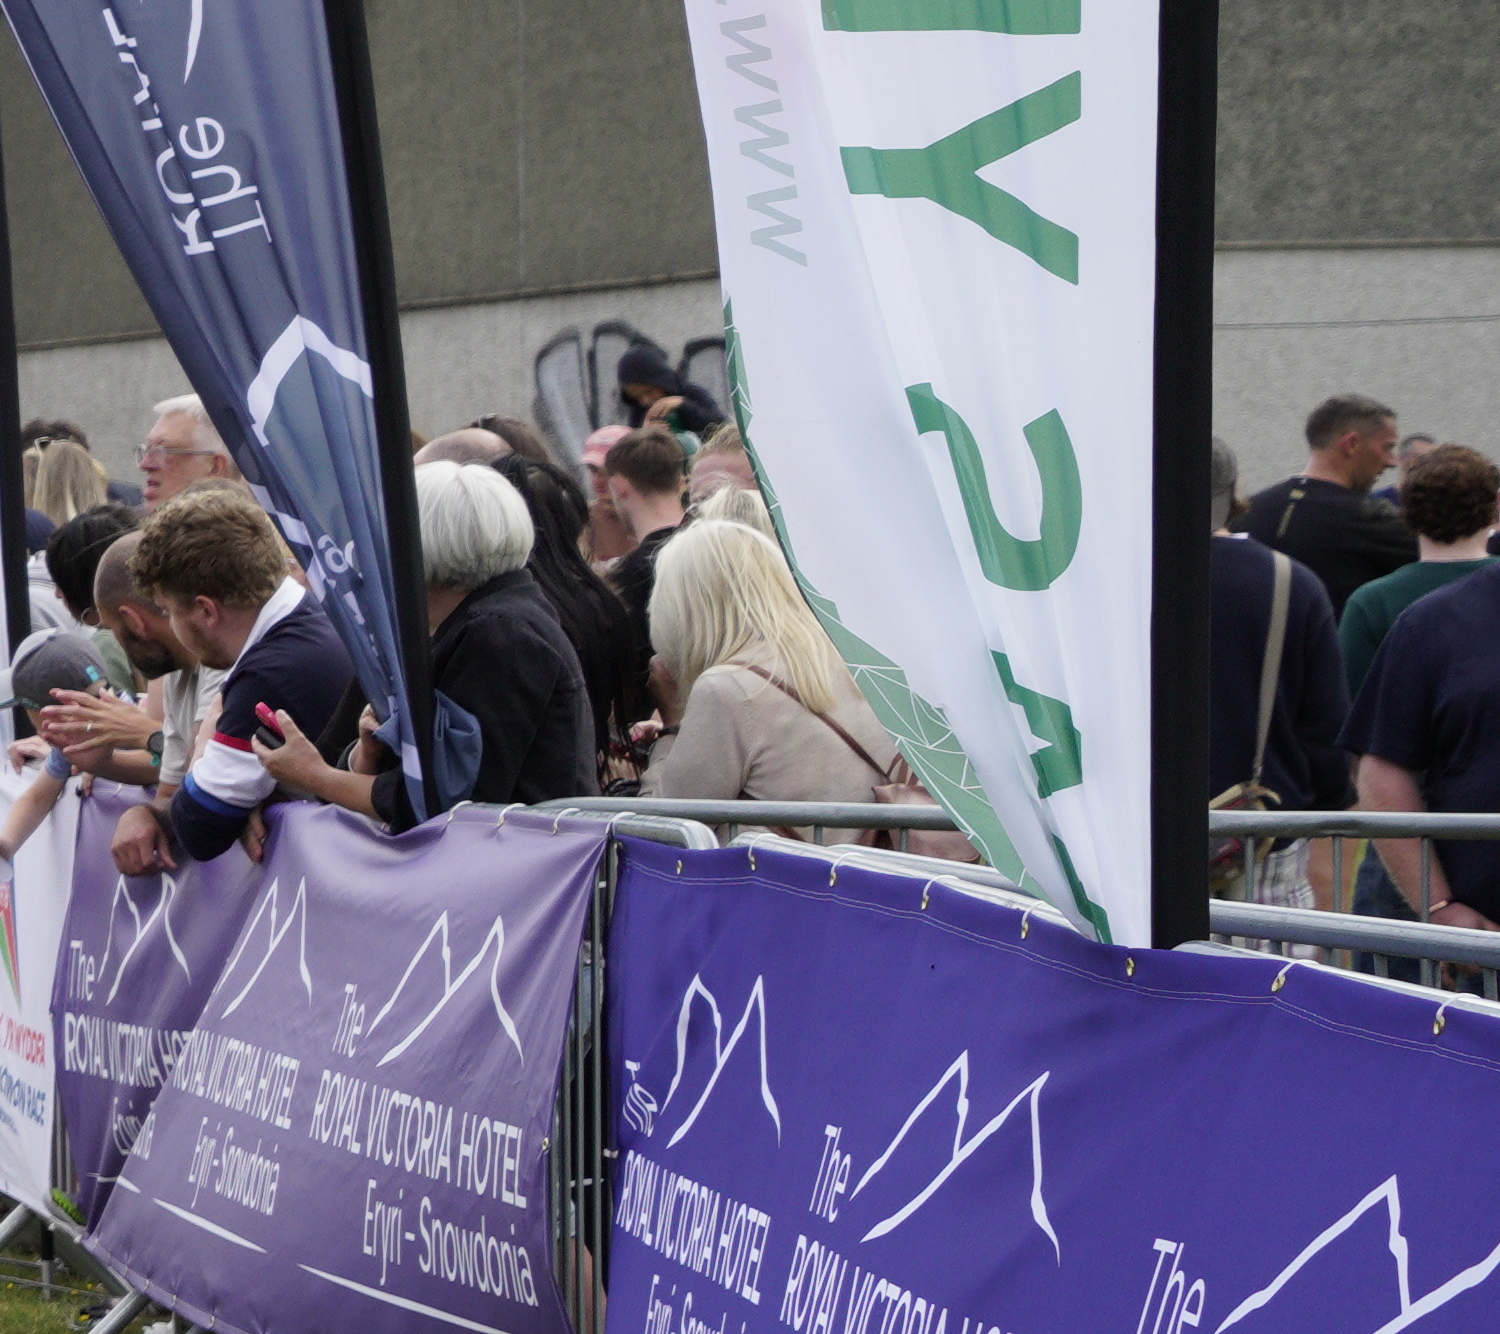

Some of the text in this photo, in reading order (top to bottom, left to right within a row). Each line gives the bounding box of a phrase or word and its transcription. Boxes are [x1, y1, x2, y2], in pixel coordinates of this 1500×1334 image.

[70, 939, 96, 1003] The
[334, 984, 365, 1057] The
[253, 1046, 299, 1131] HOTEL
[216, 1128, 280, 1215] Snowdonia
[309, 1069, 528, 1209] ROYAL VICTORIA HOTEL
[809, 1123, 852, 1226] The
[363, 1180, 539, 1307] Eryri Snowdonia
[617, 1148, 772, 1307] ROYAL VICTORIA HOTEL
